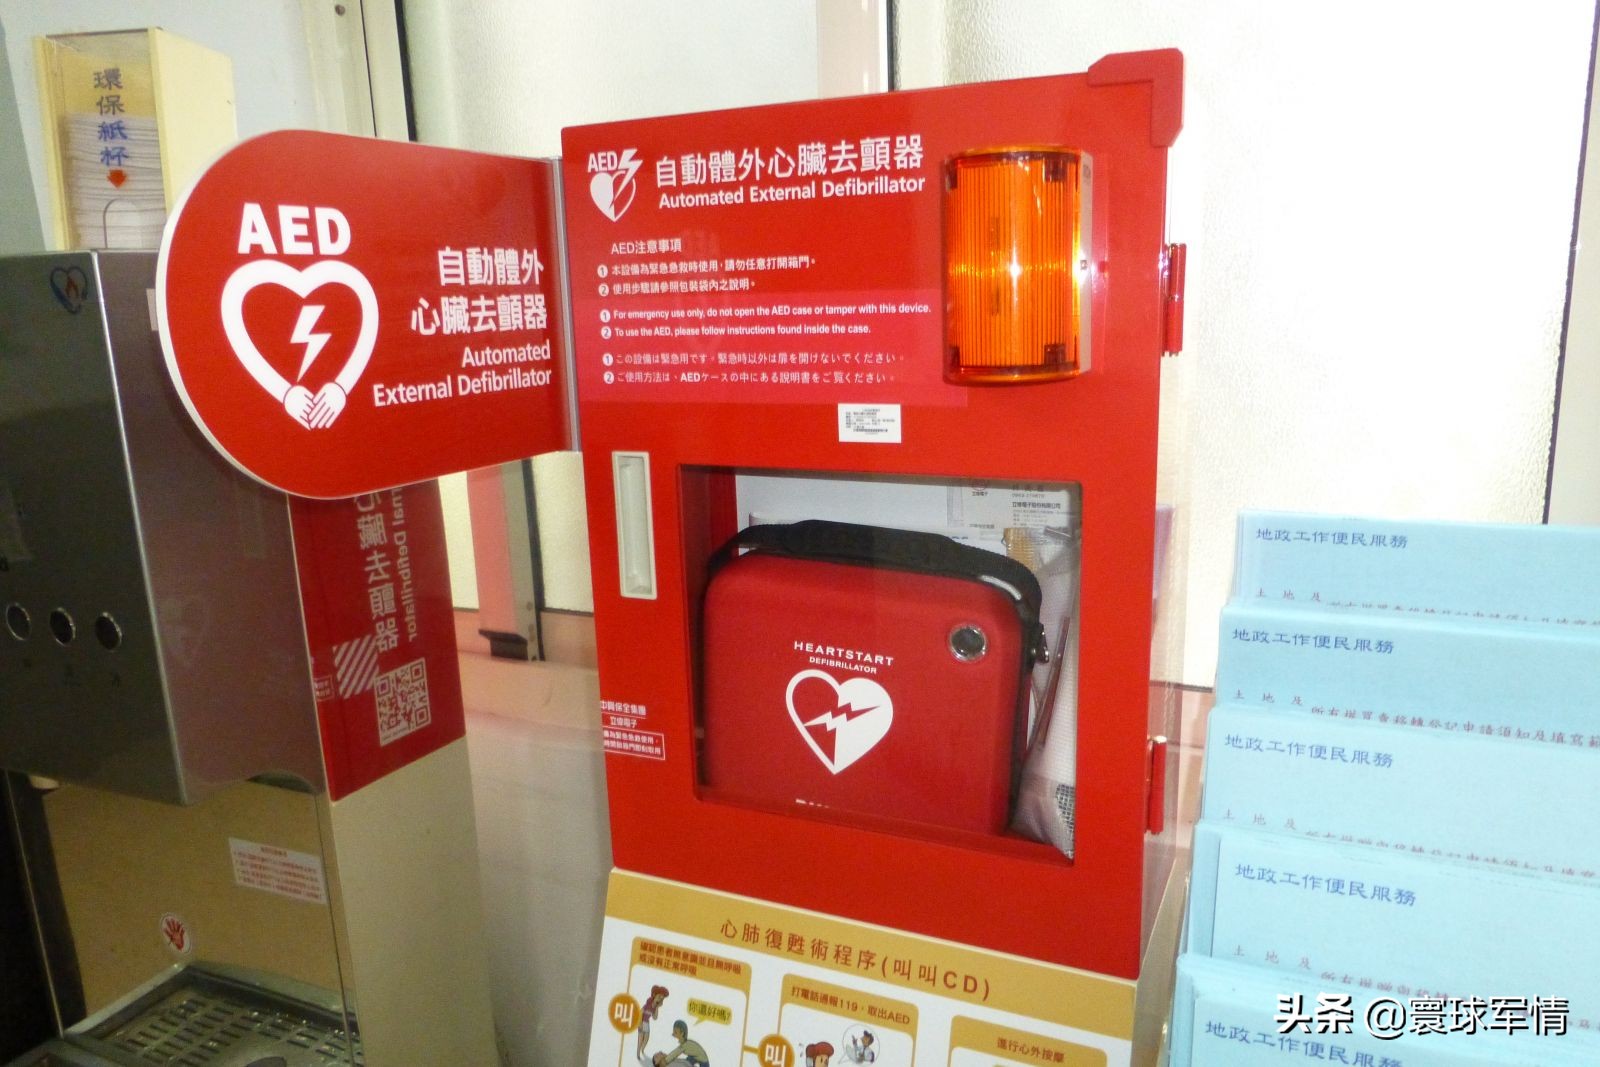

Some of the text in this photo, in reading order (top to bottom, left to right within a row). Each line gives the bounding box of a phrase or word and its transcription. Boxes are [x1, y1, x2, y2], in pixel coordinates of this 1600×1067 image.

[93, 67, 129, 166] 環保紙杯
[587, 151, 618, 172] AED
[656, 134, 923, 188] 自動體外心臟去顫器
[658, 176, 926, 209] Automated External Defibrillator
[237, 202, 351, 256] AED
[611, 239, 682, 255] AED注意事項
[437, 246, 544, 286] 自動體外
[411, 294, 547, 336] 心臟去顫器
[614, 310, 626, 319] For
[628, 309, 669, 321] emergency
[671, 310, 684, 318] use
[687, 308, 705, 319] only,
[707, 307, 718, 317] do
[719, 308, 732, 317] not
[734, 308, 755, 318] open
[757, 306, 769, 316] the
[771, 305, 790, 315] AED
[792, 306, 812, 315] case
[814, 306, 824, 315] or
[826, 305, 857, 317] tamper
[859, 304, 877, 314] with
[879, 304, 897, 314] this
[898, 303, 931, 313] device.
[615, 328, 624, 337] To
[625, 329, 639, 337] use
[640, 327, 652, 336] the
[654, 327, 673, 337] AED,
[675, 326, 700, 338] please
[701, 326, 725, 336] follow
[727, 325, 775, 336] instructions
[777, 324, 802, 334] found
[804, 324, 829, 334] inside
[832, 324, 845, 334] the
[848, 325, 871, 334] case.
[461, 340, 551, 368] Automated
[373, 367, 552, 407] External Defibrillator
[1255, 527, 1408, 549] 地政工作便民服務
[794, 640, 894, 666] HEARTSTART
[1232, 628, 1395, 654] 地政工作便民服務
[809, 656, 877, 675] DEFIBRILLATOR
[1224, 733, 1394, 769] 地政工作便民服務
[1235, 863, 1417, 907] 地政工作便民服務
[614, 1002, 634, 1028] 叫
[765, 1043, 786, 1067] 叫
